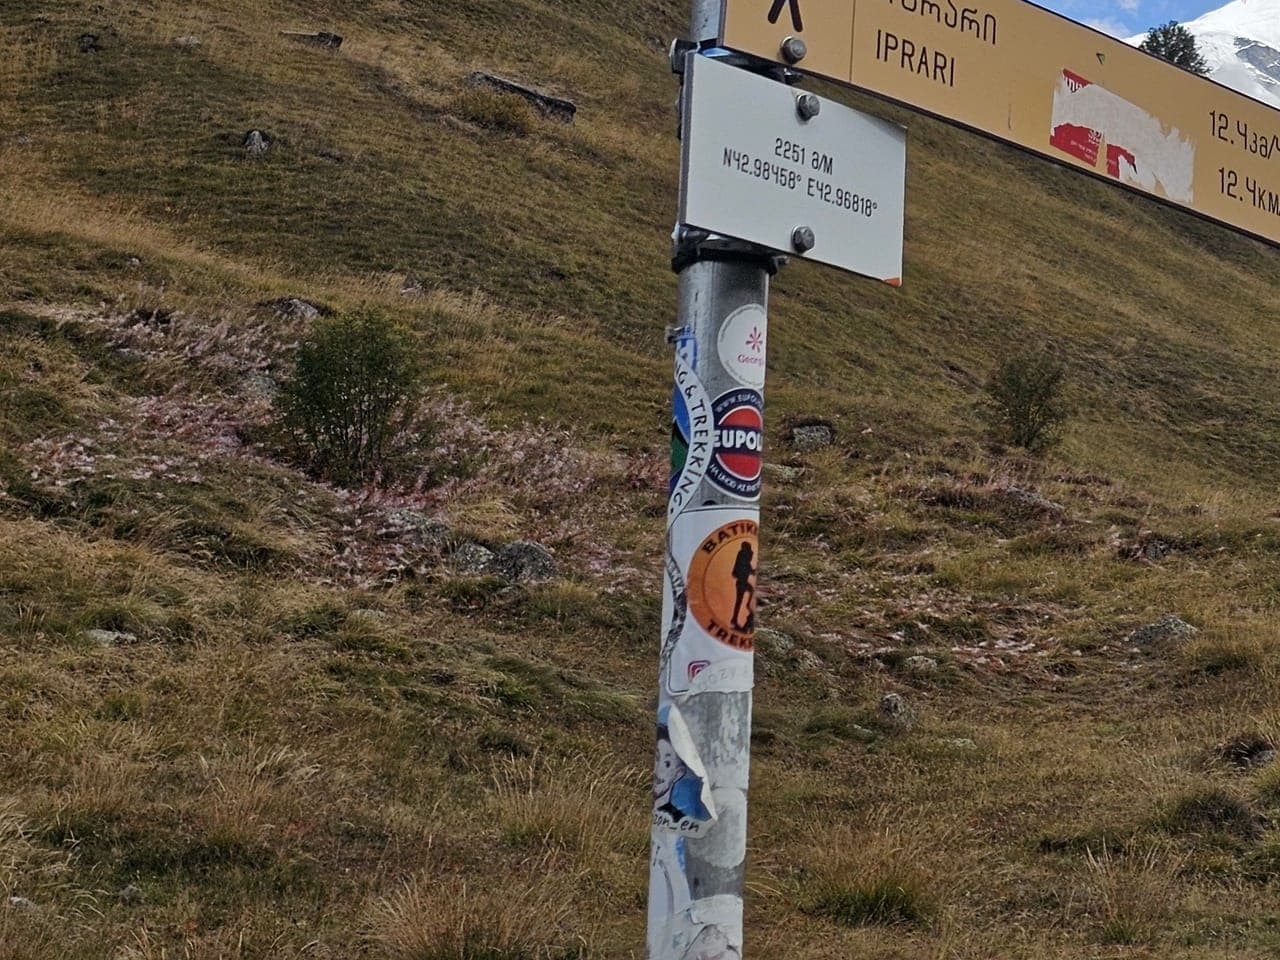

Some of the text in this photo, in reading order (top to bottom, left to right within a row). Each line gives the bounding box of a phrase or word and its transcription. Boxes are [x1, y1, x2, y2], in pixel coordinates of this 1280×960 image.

[876, 29, 954, 87] IPRARI
[774, 137, 805, 165] 2251
[723, 147, 877, 217] N42.98458° E42.96818°
